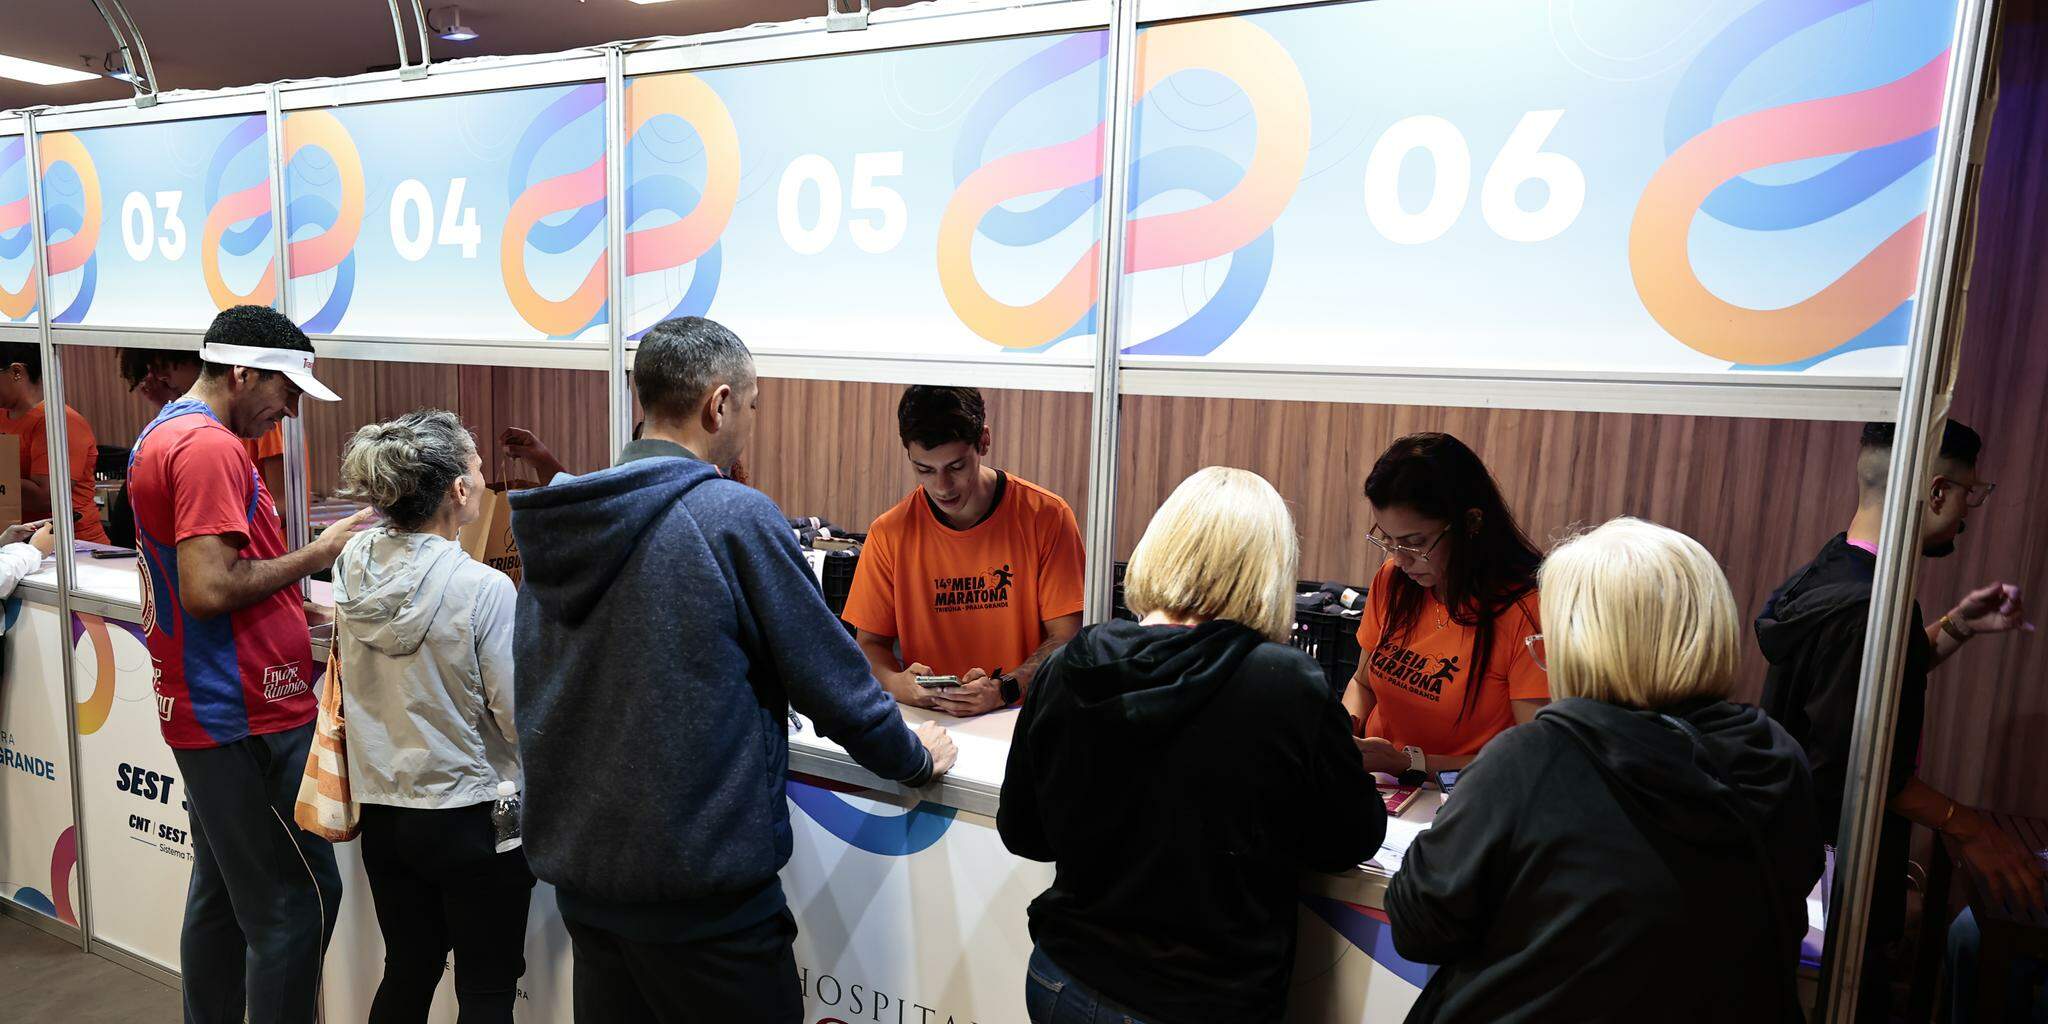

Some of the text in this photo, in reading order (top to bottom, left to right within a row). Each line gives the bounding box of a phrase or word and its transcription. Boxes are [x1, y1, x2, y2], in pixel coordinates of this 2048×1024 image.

[1363, 108, 1586, 245] 06
[389, 177, 482, 262] 04
[776, 150, 908, 255] 05
[121, 190, 187, 262] 03
[489, 555, 522, 571] TRIBU
[952, 577, 985, 590] MEIA
[935, 588, 1007, 605] MARATONA
[116, 762, 175, 805] SEST
[128, 814, 187, 845] CNT SEST
[159, 843, 186, 860] Sistema
[800, 967, 978, 1024] OSPIT
